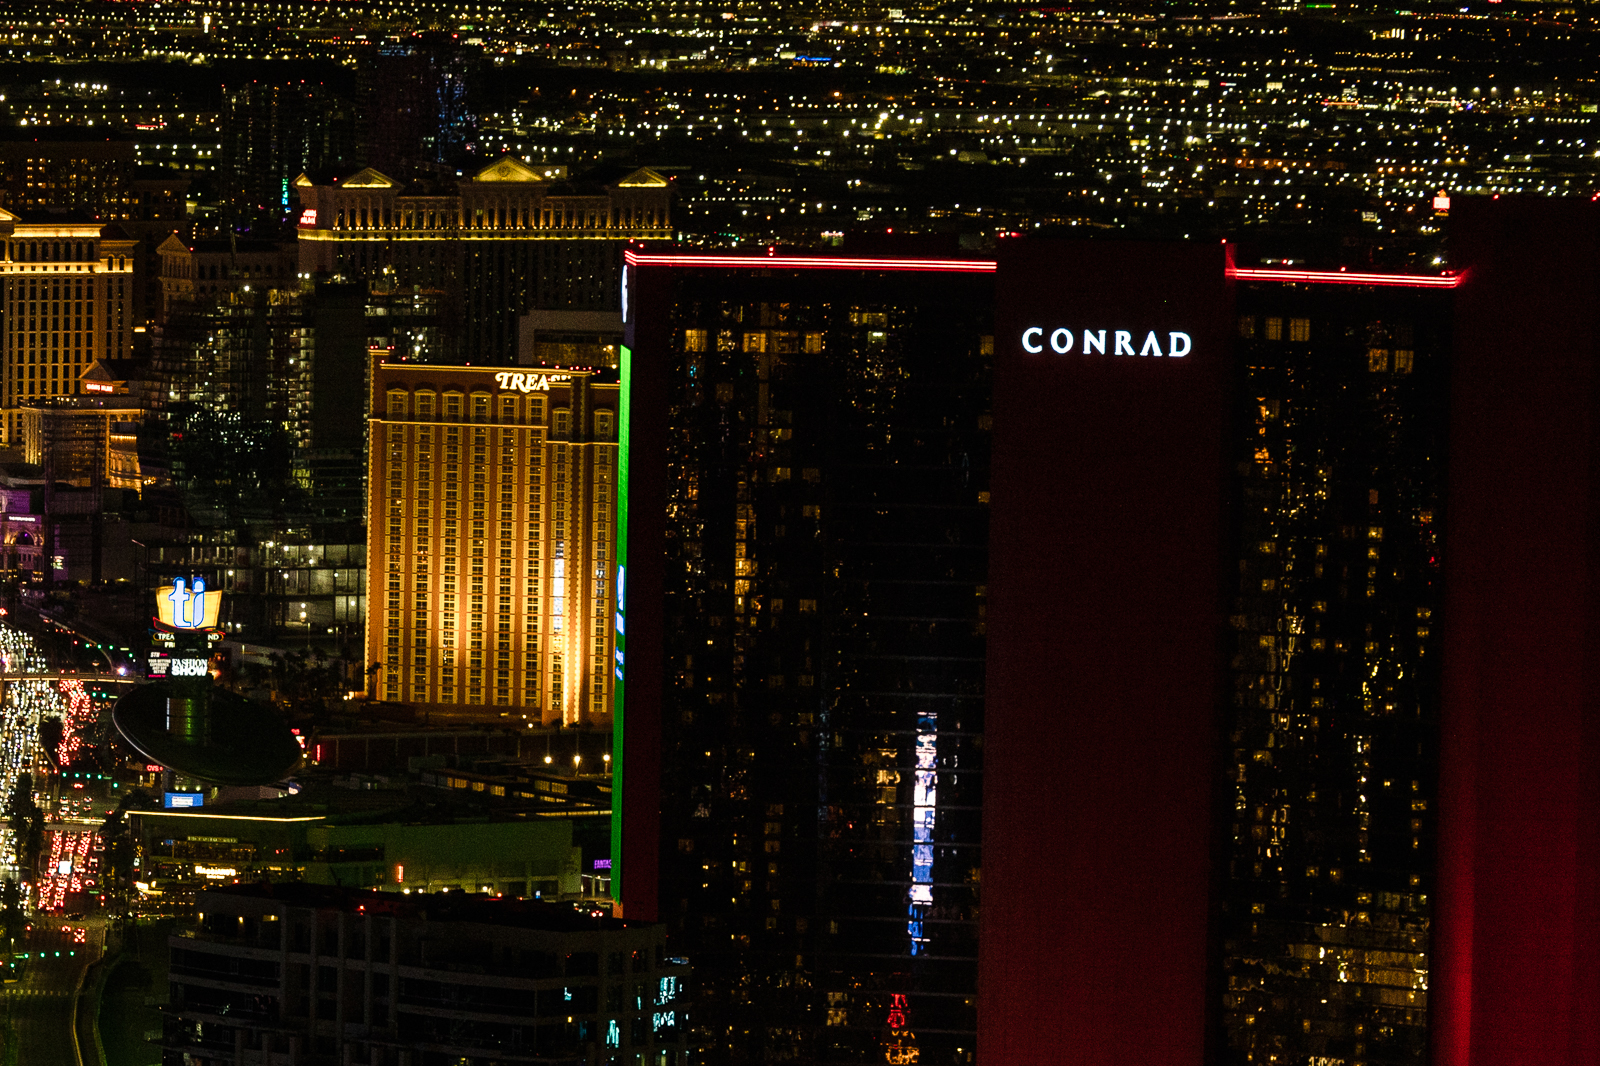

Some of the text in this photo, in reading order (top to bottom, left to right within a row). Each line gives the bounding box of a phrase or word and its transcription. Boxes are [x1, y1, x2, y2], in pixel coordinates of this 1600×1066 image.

[1021, 326, 1192, 357] CONRAD
[495, 372, 572, 393] TREA
[171, 658, 208, 668] FASHION
[171, 666, 208, 676] SHOW
